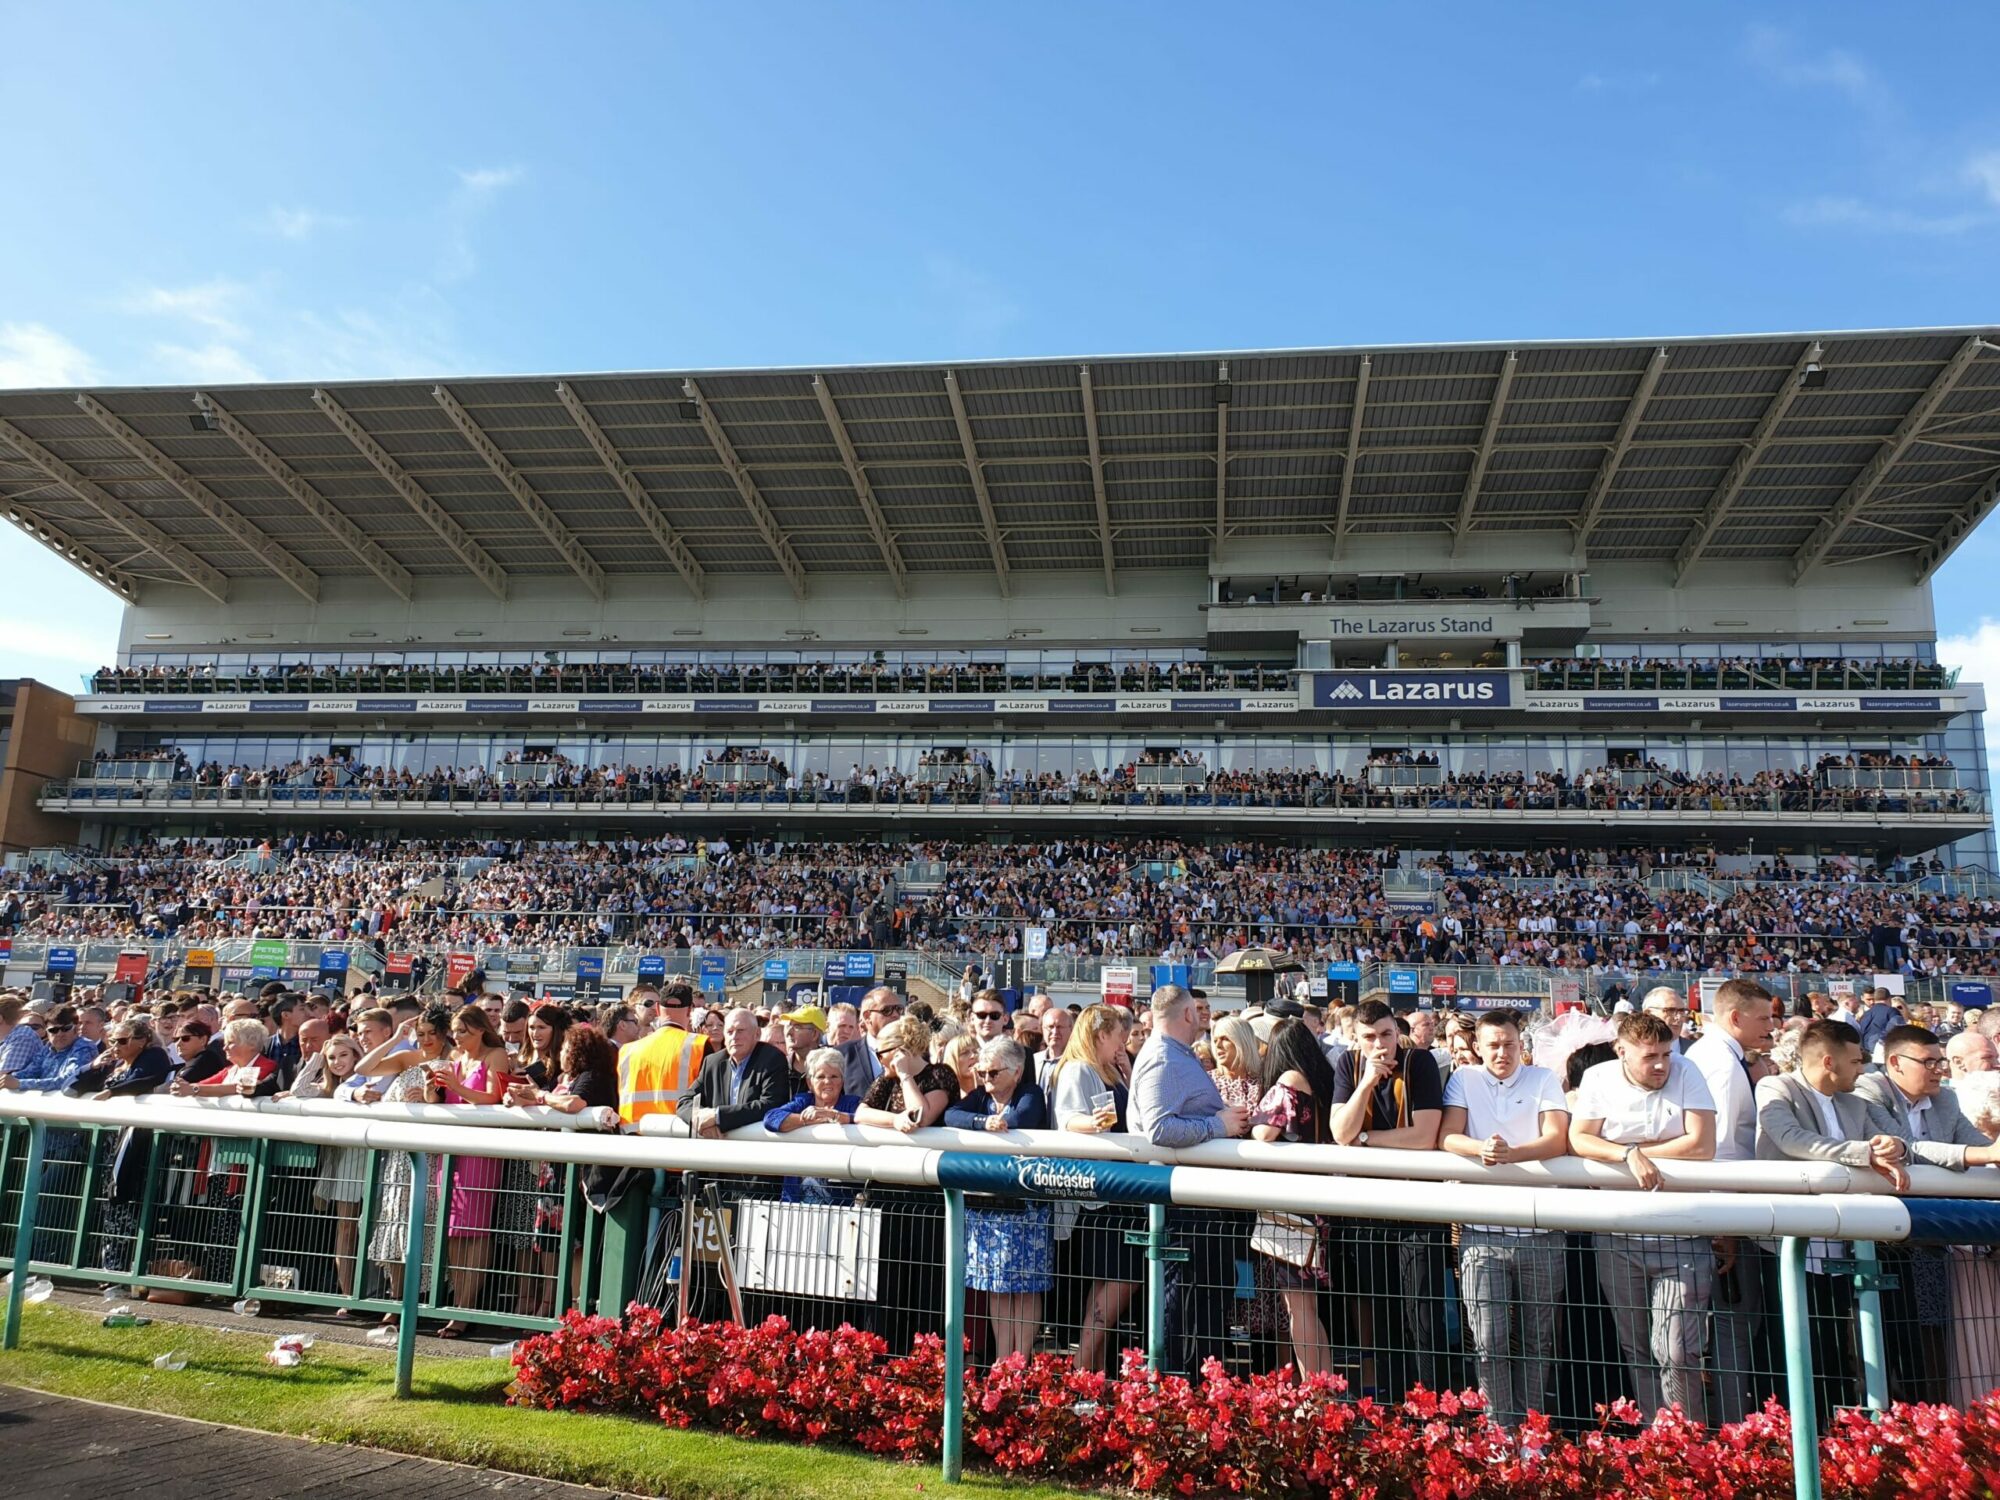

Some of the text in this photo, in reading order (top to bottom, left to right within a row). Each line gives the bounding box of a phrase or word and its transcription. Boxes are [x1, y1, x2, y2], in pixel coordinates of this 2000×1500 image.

[1330, 617, 1492, 634] The Lazarus Stand
[1369, 679, 1494, 700] Lazarus
[1540, 700, 1579, 708] Lazarus
[1675, 700, 1715, 708] Lazarus
[1814, 700, 1855, 708] Lazarus
[256, 946, 284, 954] PETER
[1477, 999, 1532, 1007] TOTEPOOL
[1033, 1170, 1096, 1189] doncaster
[1045, 1188, 1097, 1198] racing & events
